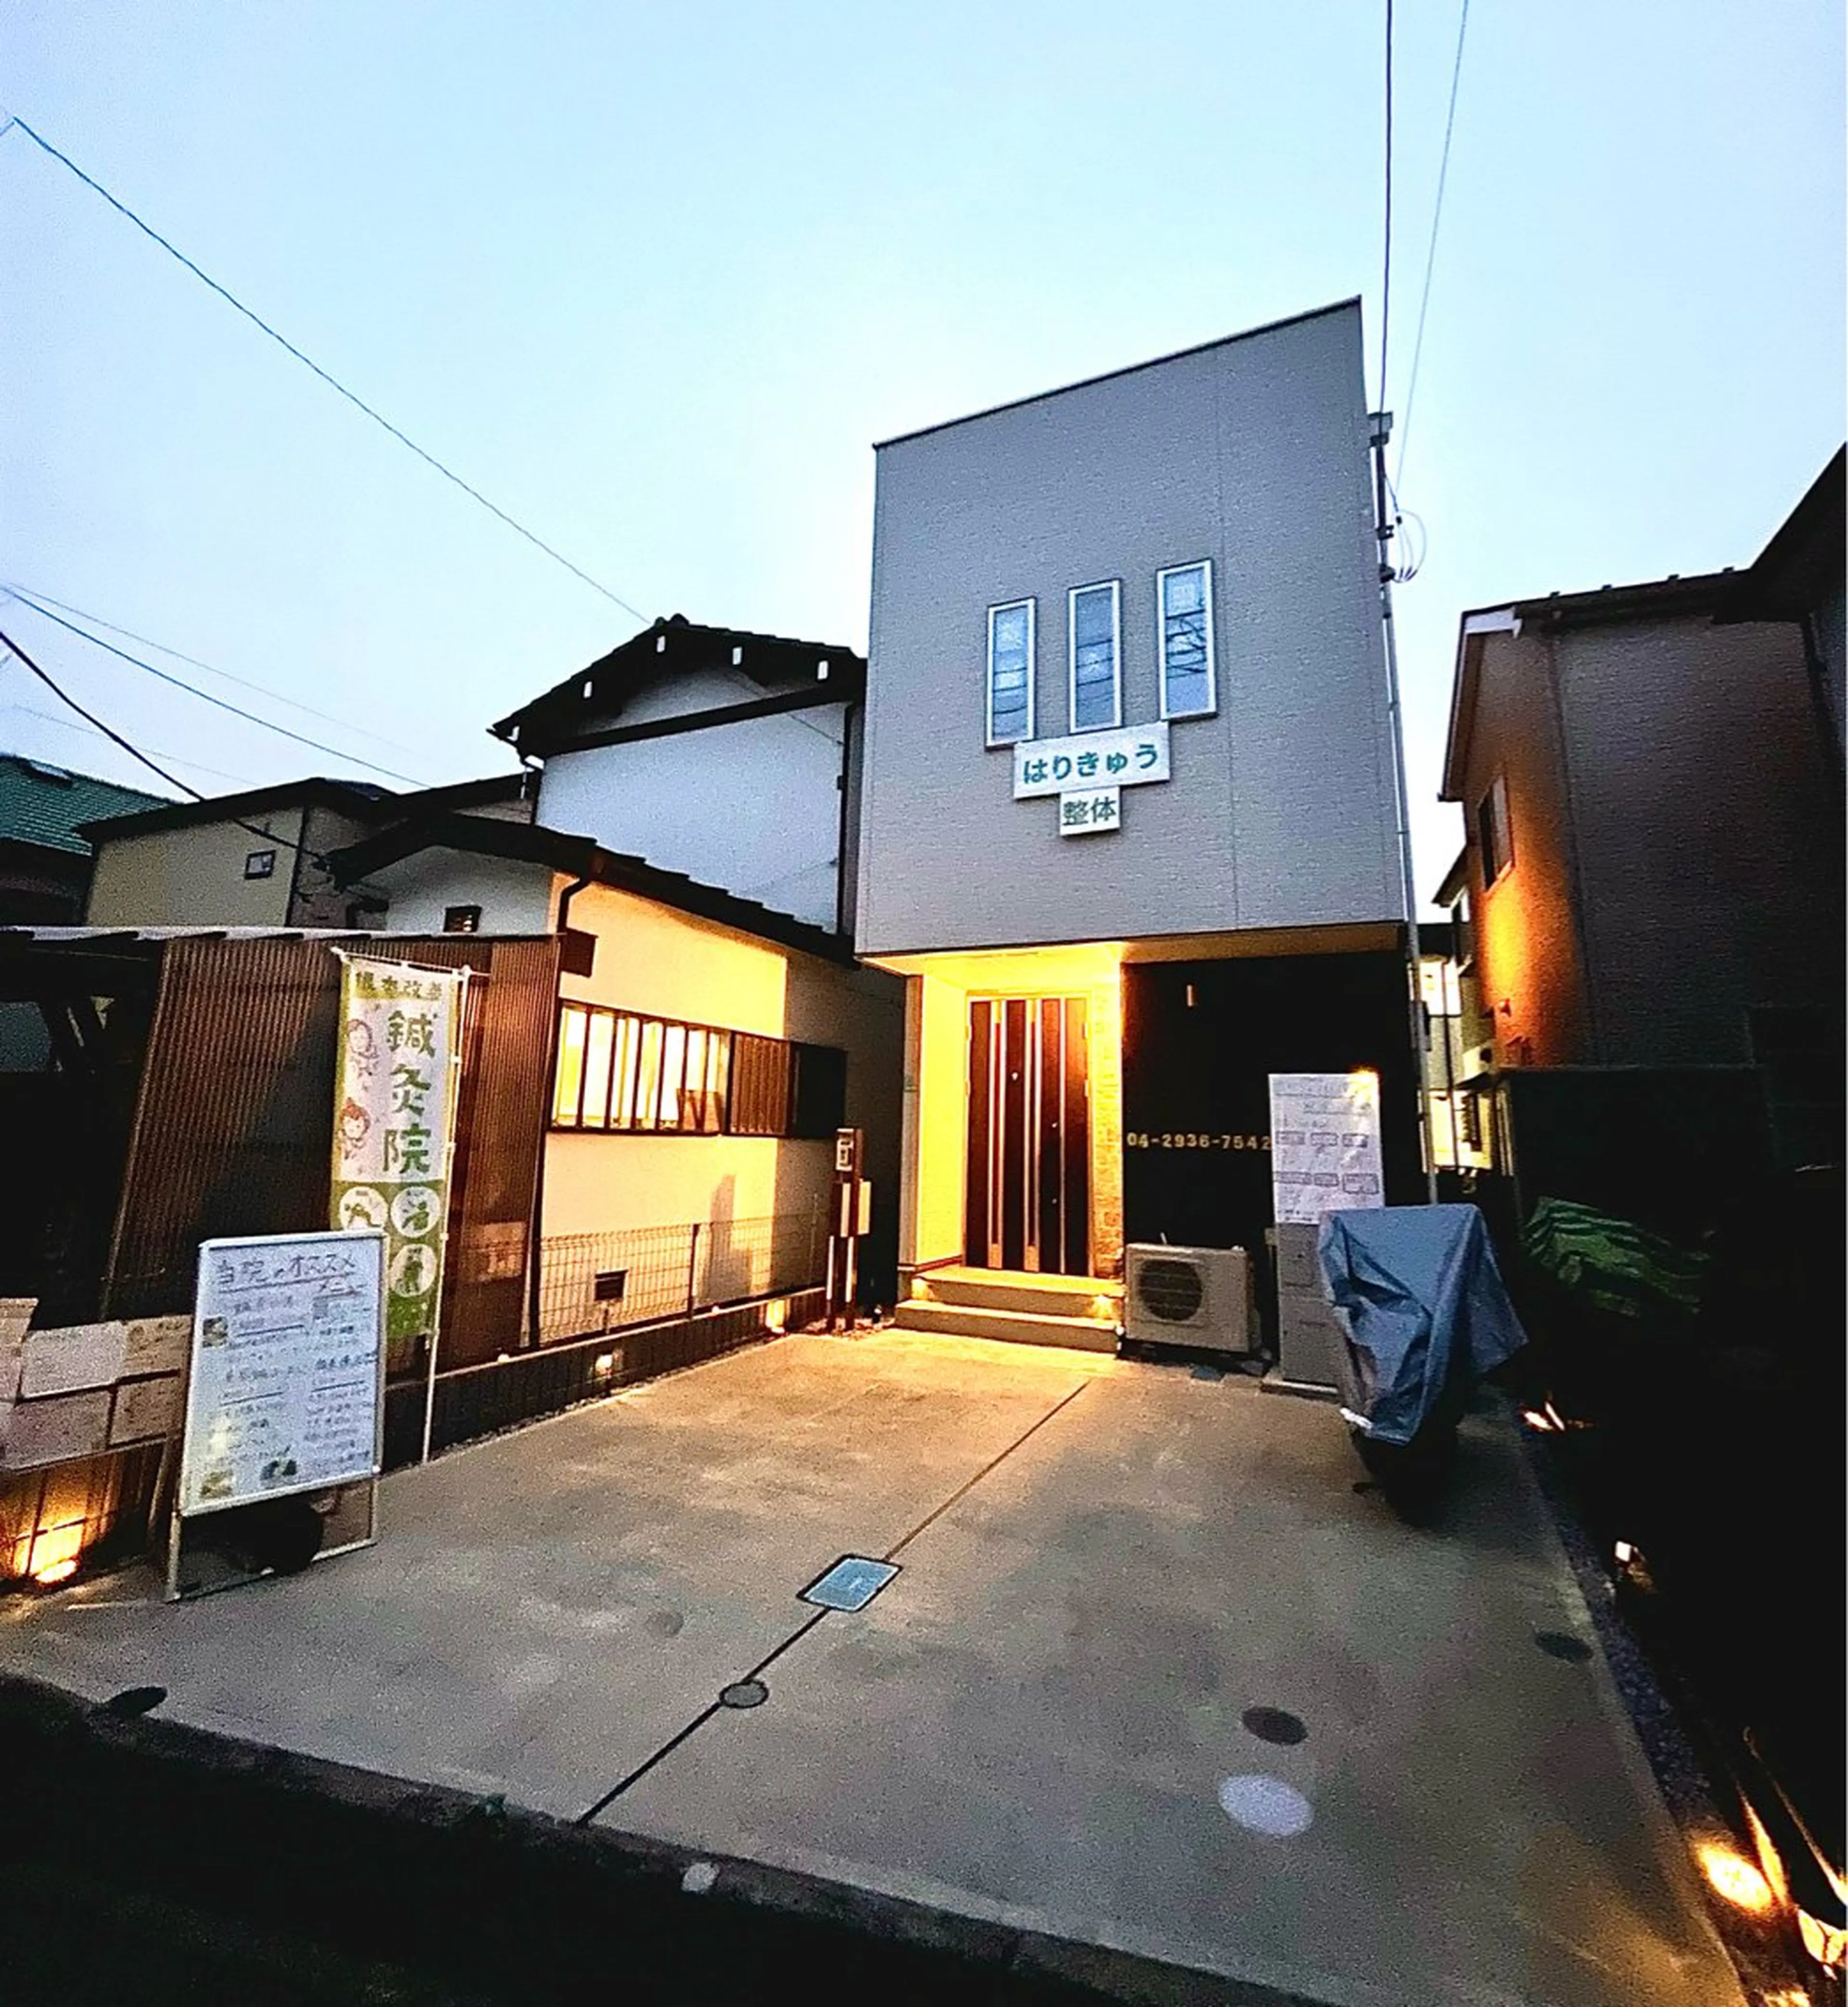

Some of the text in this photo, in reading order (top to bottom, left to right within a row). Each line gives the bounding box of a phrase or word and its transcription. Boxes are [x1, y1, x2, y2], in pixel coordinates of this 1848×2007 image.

[1024, 744, 1158, 784] はりきゅう
[1063, 796, 1116, 826] 整体
[383, 1010, 436, 1173] 鍼灸院
[1127, 1132, 1271, 1150] 04-2936-7542
